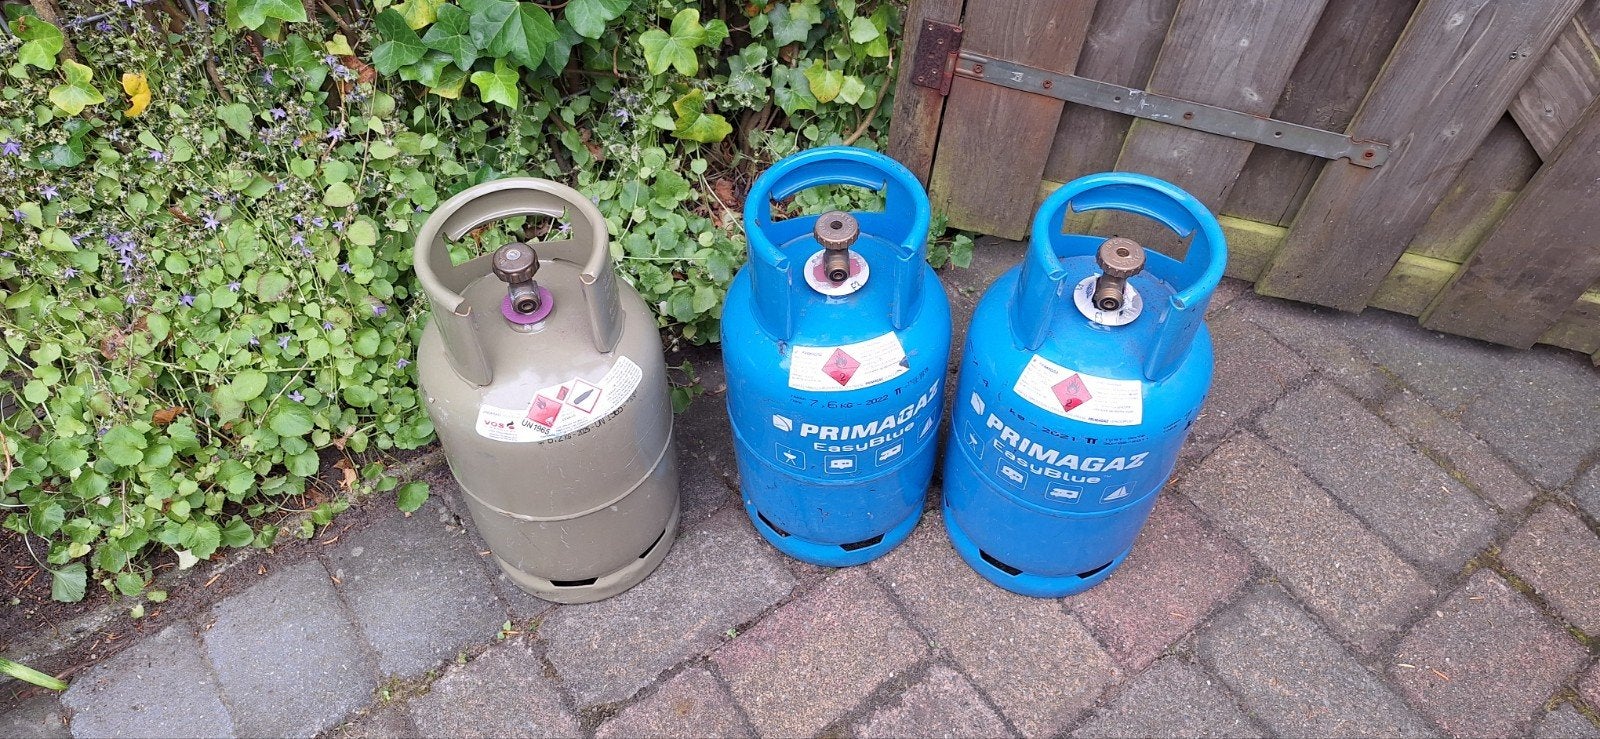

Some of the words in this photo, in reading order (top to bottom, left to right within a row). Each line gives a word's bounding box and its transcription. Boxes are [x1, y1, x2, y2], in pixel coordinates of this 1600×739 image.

[839, 373, 846, 382] 2
[521, 419, 534, 429] UN
[533, 424, 551, 435] 1965
[800, 379, 940, 441] PRIMAGAZ
[813, 421, 916, 453] EasyBlue
[986, 412, 1150, 472] PRIMAGAZ
[993, 438, 1101, 484] EasyBlue
